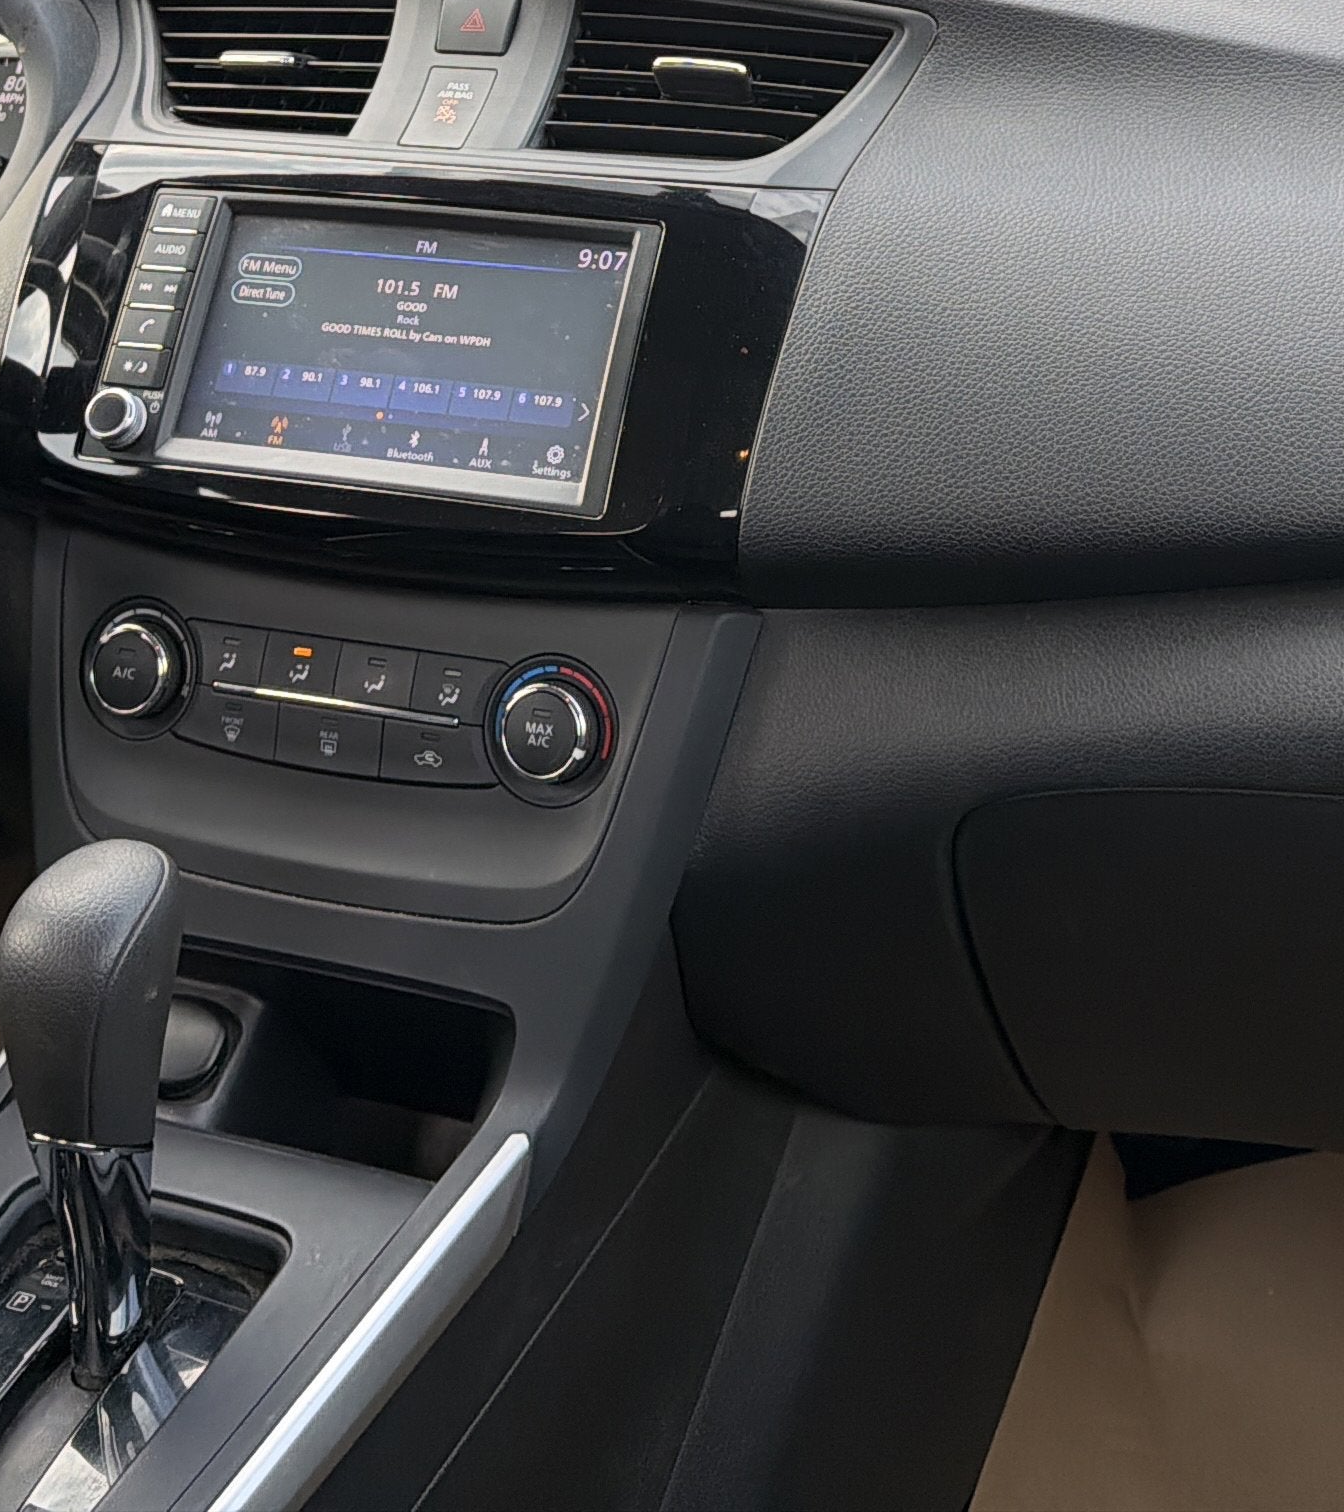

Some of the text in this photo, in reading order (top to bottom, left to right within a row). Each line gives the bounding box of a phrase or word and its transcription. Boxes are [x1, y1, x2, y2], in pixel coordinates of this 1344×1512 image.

[3, 76, 26, 92] 80
[446, 82, 470, 91] PASS
[437, 90, 474, 100] AIR BAG
[172, 208, 201, 219] MENU
[154, 244, 186, 255] AUDIO
[416, 240, 438, 254] FM
[577, 248, 628, 271] 9:07
[242, 259, 297, 275] FM Menu
[238, 284, 286, 300] Direct Tune
[377, 278, 459, 300] 101.5 FM
[396, 301, 428, 313] GOOD
[396, 314, 420, 326] Rock
[321, 322, 492, 348] GOOD TIMES ROLL by Cars on WPDH
[244, 365, 267, 377] 87.9
[281, 368, 323, 383] 2 90.1
[340, 374, 381, 389] 3 98.1
[398, 380, 440, 395] 4 106.1
[142, 390, 165, 400] PUSH
[458, 387, 501, 401] 5 107.9
[518, 392, 563, 408] 6 107.9
[200, 427, 218, 438] AM
[267, 435, 284, 446] FM
[333, 442, 352, 454] USB
[386, 447, 434, 463] Bluetooth
[468, 457, 493, 470] AUX
[531, 464, 572, 480] Settings
[112, 666, 136, 681] A/C
[221, 714, 245, 726] FRONT
[319, 730, 340, 740] REAR
[525, 720, 554, 737] MAX
[527, 734, 551, 749] A/C
[15, 1295, 30, 1307] P
